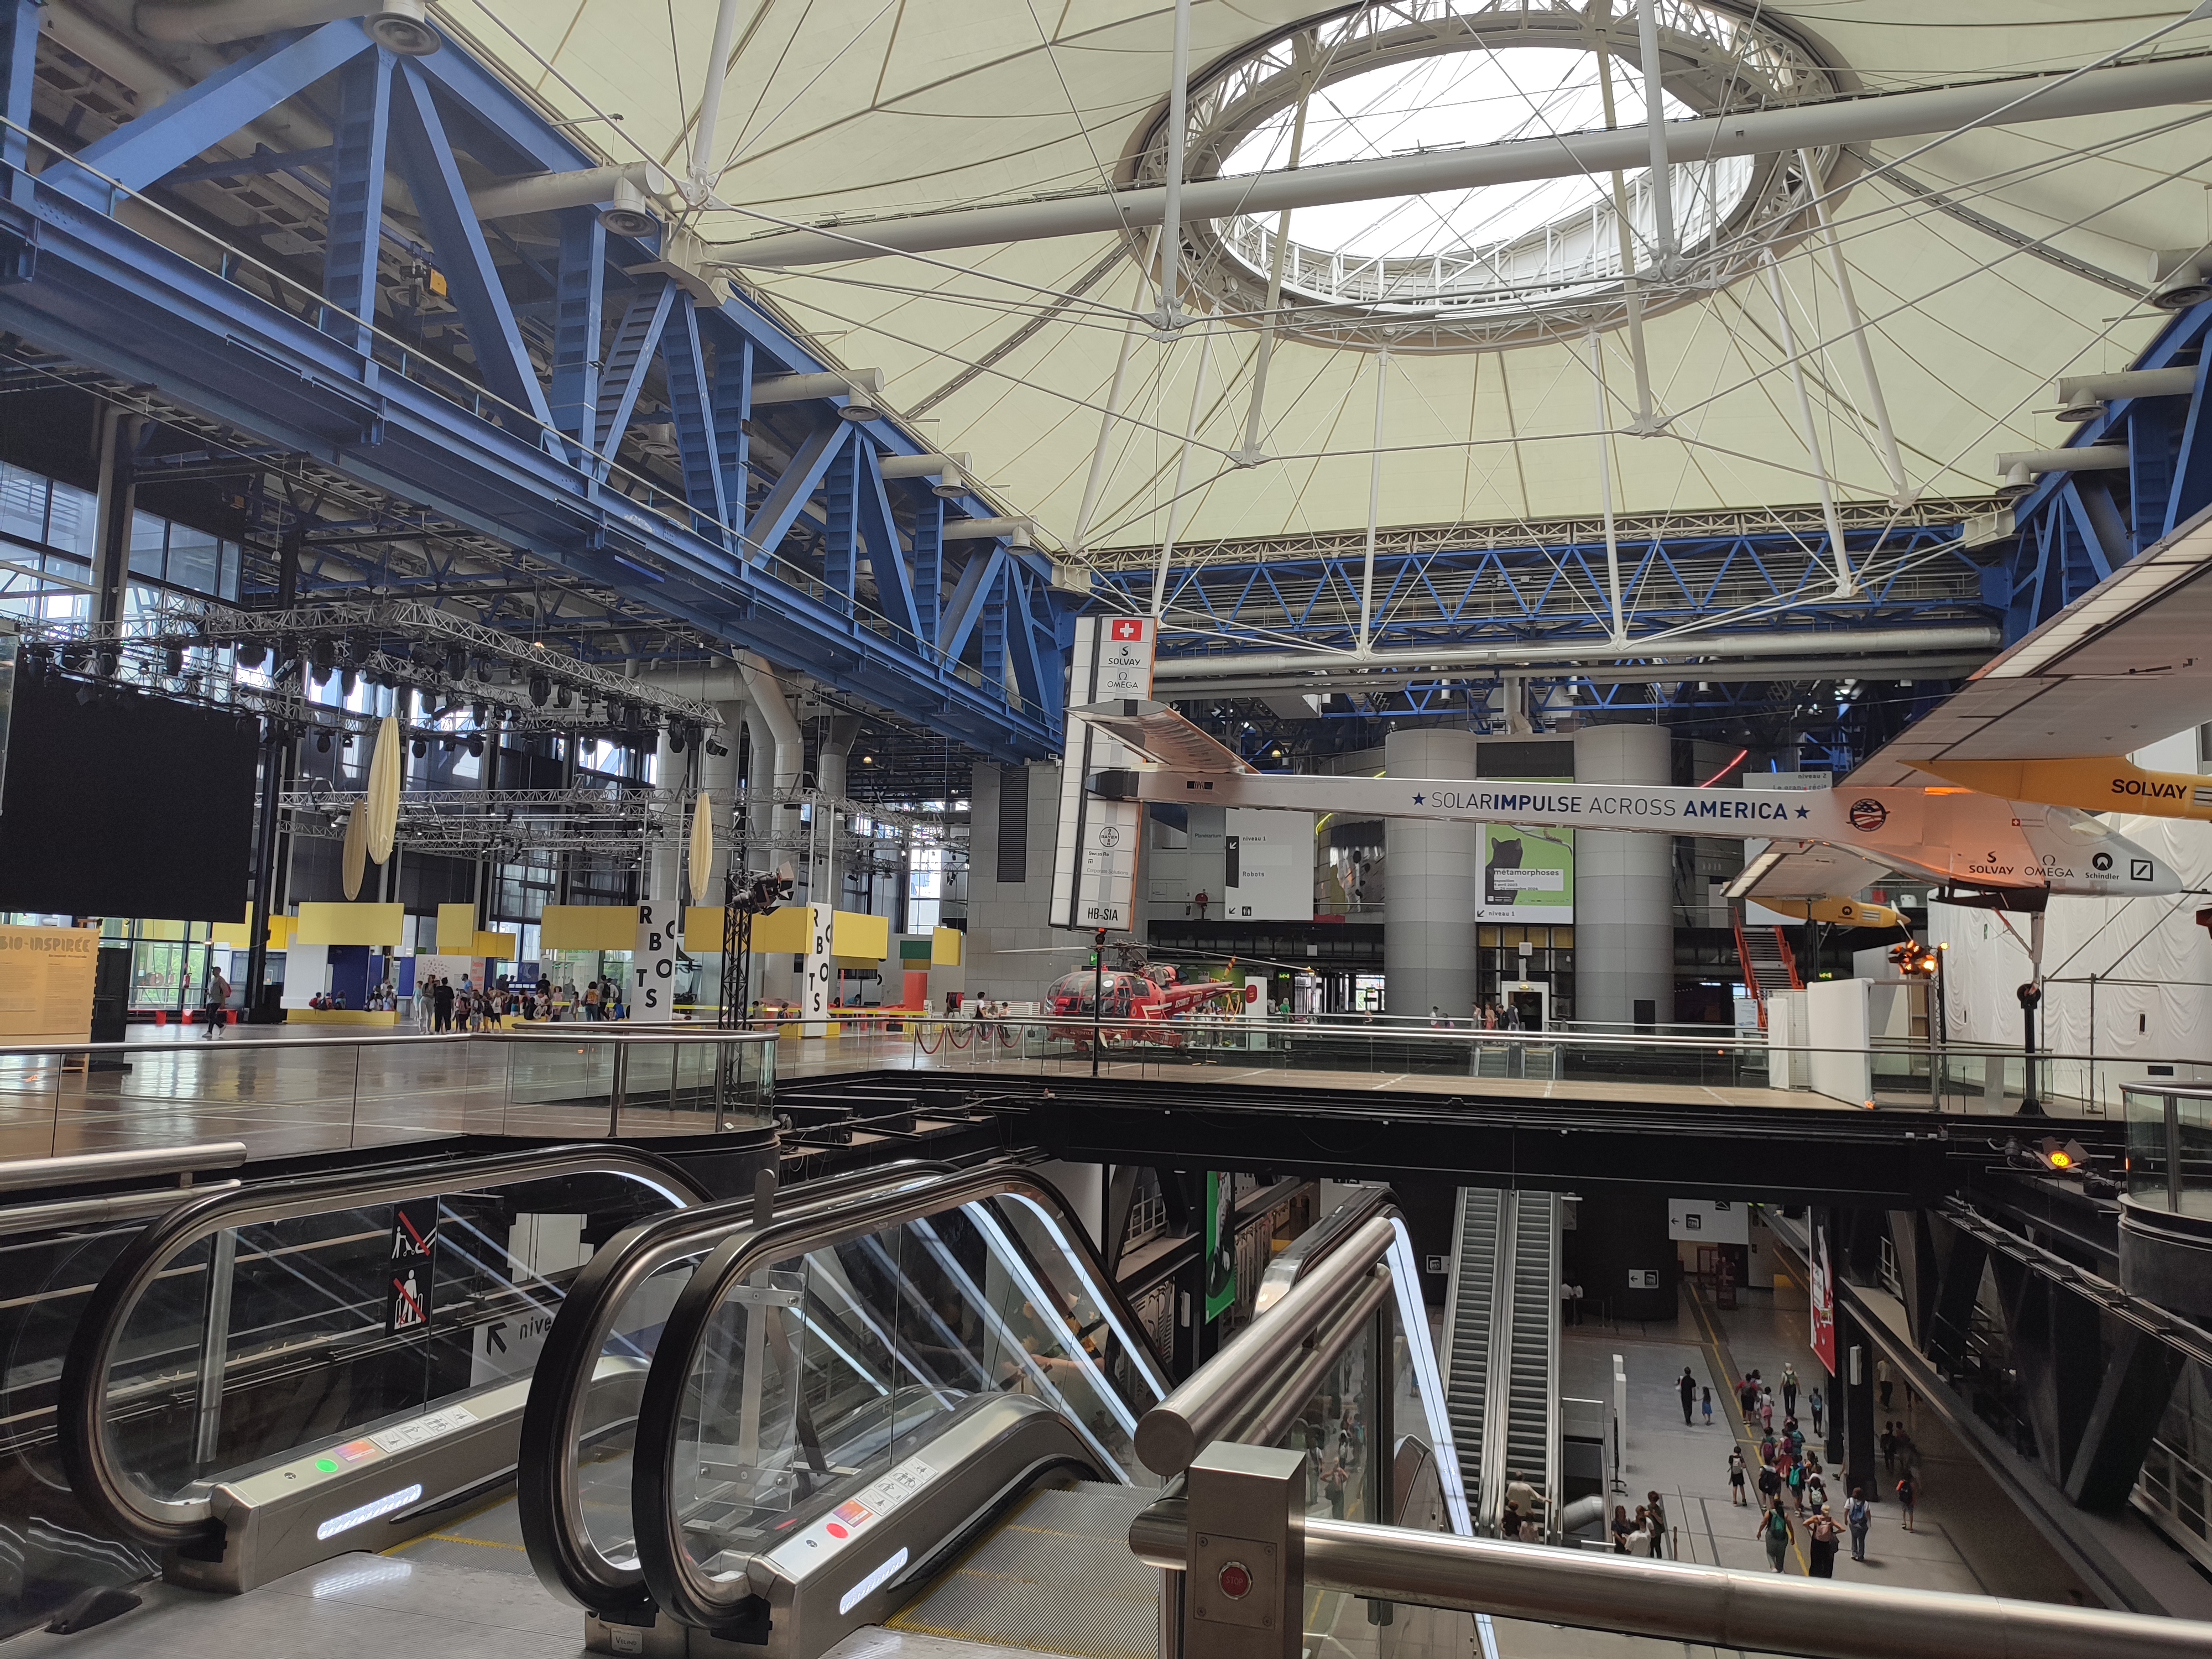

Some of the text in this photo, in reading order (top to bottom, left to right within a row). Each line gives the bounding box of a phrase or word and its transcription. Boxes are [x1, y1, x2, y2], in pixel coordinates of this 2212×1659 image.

[1108, 658, 1141, 666] SOLVAY
[2111, 779, 2187, 799] SOLVAY
[1431, 791, 1788, 820] SOLARIMPULSE ACROSS AMERICA
[1969, 865, 2014, 875] SOLVAY
[2024, 866, 2074, 878] OMEGA
[1087, 907, 1118, 921] HB-SIA
[520, 1316, 552, 1340] nive
[1225, 1575, 1244, 1586] STOP
